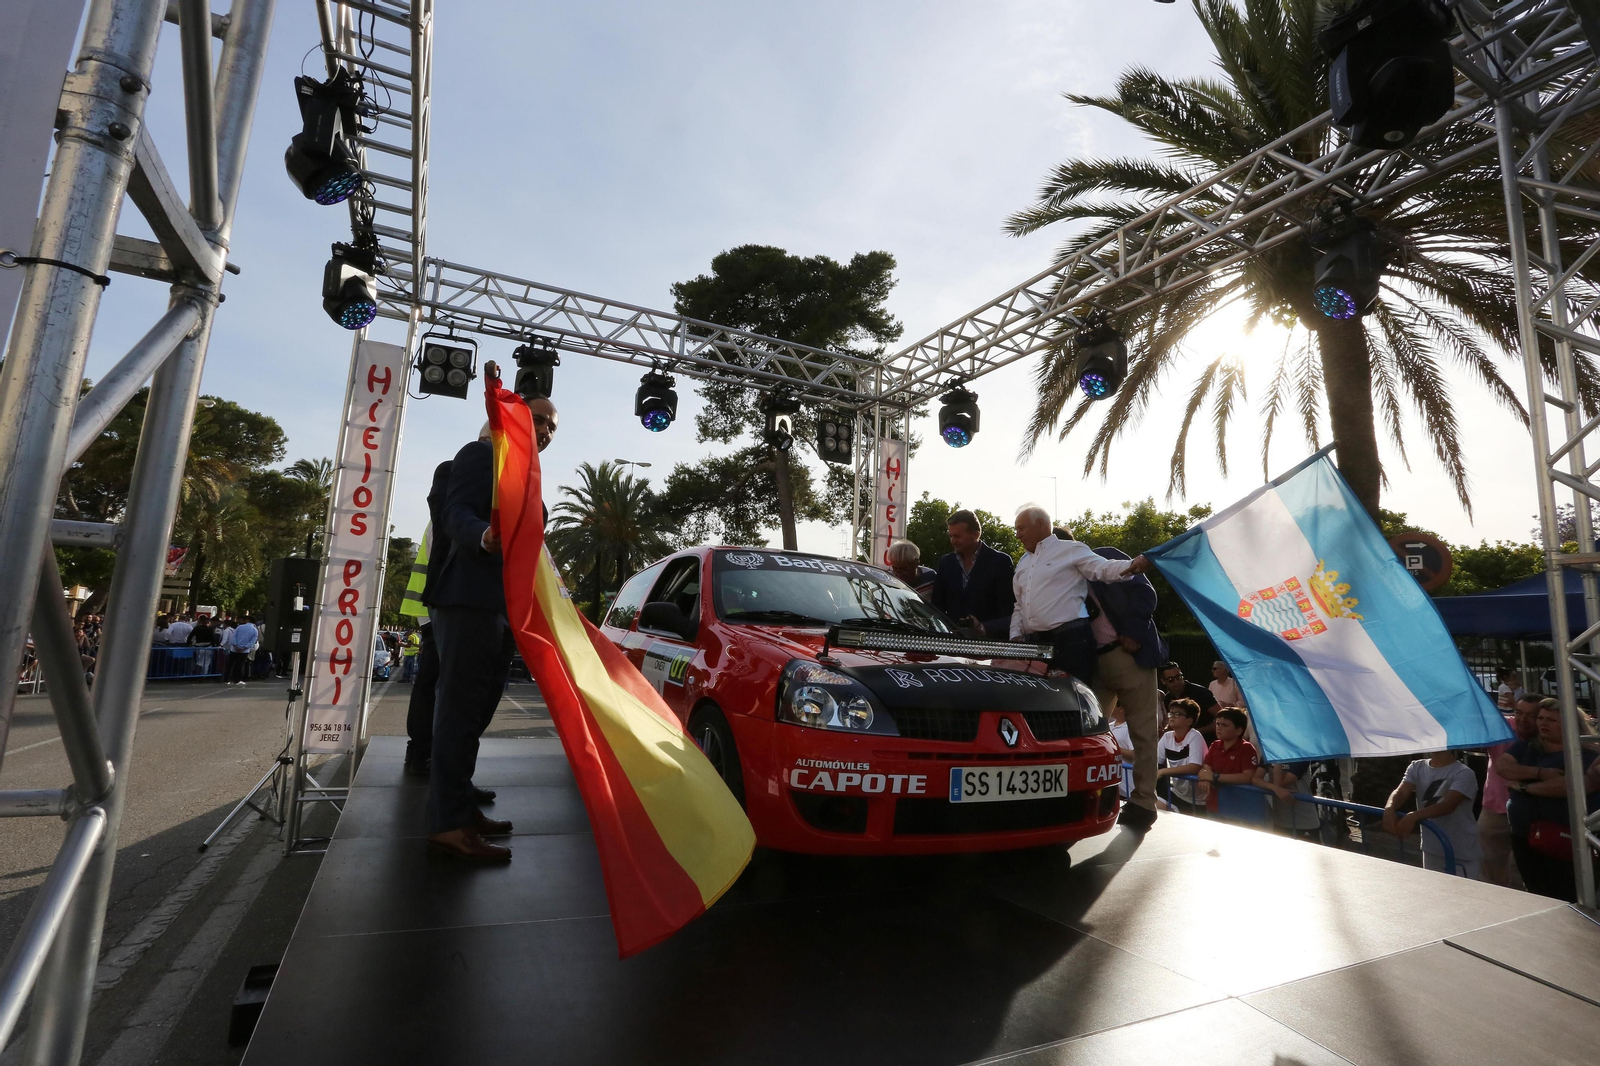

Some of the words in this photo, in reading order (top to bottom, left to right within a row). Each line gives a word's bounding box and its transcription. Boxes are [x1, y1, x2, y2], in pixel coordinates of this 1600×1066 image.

[329, 559, 363, 705] PROHI
[670, 654, 691, 679] 07
[922, 668, 1060, 692] ROTUGRAFIC
[310, 723, 322, 732] 956
[323, 723, 332, 732] 34
[334, 723, 342, 732] 18
[343, 723, 352, 732] 14
[319, 733, 340, 742] JEREZ
[795, 758, 870, 771] AUTOMÓVILES
[790, 768, 927, 794] CAPOTE
